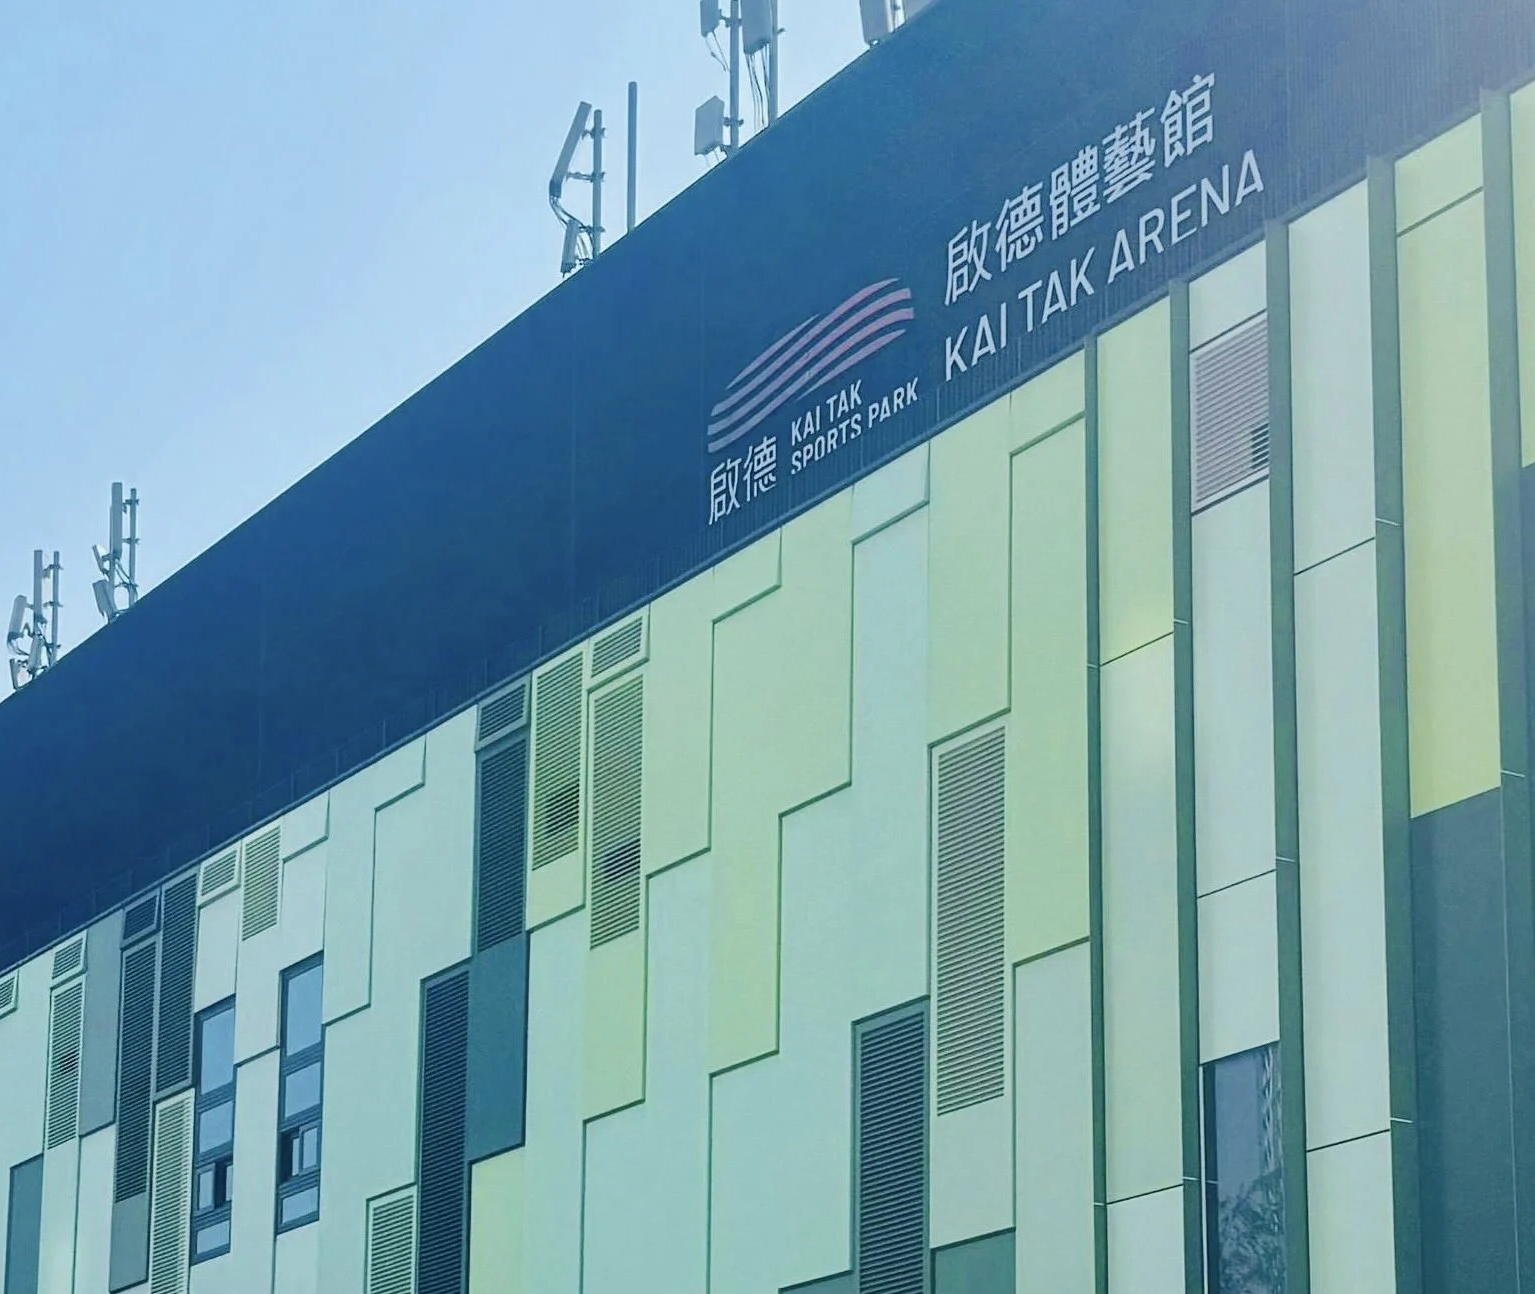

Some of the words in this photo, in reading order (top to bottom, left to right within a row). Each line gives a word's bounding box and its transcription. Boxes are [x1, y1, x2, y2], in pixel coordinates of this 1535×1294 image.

[944, 73, 1215, 306] 啟德體藝館
[945, 302, 1007, 381] KAI
[1018, 247, 1095, 332] TAK
[1107, 149, 1264, 284] ARENA
[790, 413, 862, 475] SPORTS
[868, 377, 918, 428] PARK
[791, 405, 821, 446] KAI
[826, 379, 862, 422] TAK
[708, 436, 777, 525] 啟德
